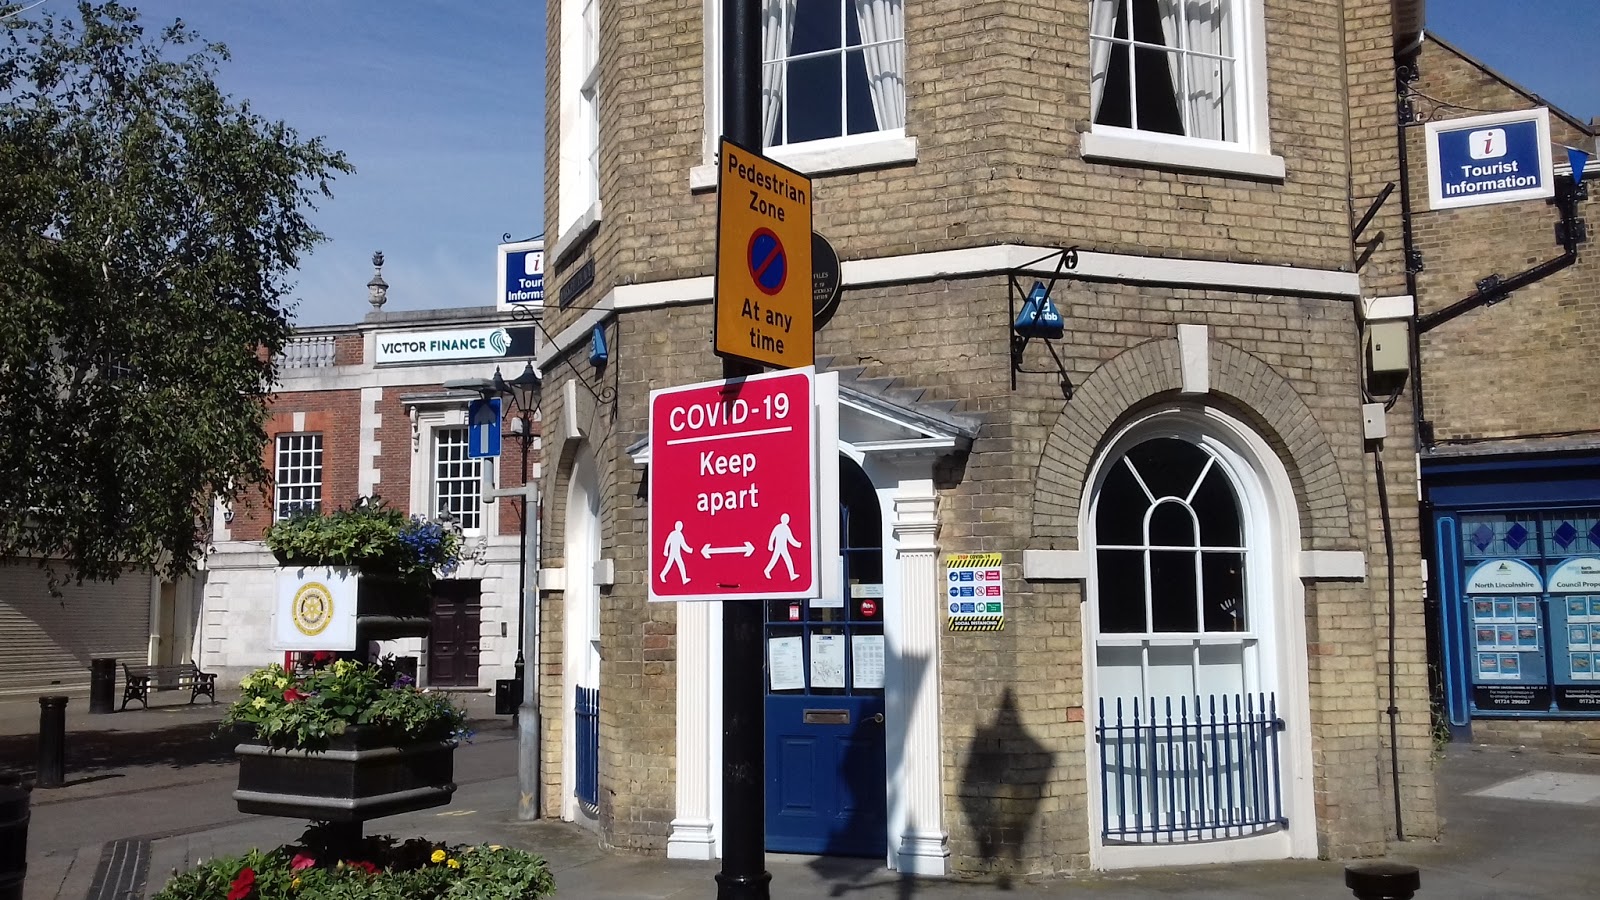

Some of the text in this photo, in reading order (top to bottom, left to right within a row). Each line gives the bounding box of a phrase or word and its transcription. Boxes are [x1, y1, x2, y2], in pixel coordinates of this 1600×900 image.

[728, 152, 806, 206] Pedestrian
[1461, 159, 1519, 178] Tourist
[1446, 174, 1537, 195] Information
[749, 190, 786, 222] Zone
[741, 297, 793, 334] At any
[381, 338, 486, 355] VICTOR FINANCE
[749, 327, 785, 355] time
[669, 392, 791, 433] COVID-19
[699, 450, 757, 479] Keep
[696, 483, 760, 516] apart
[1495, 581, 1535, 589] Lincolnshire
